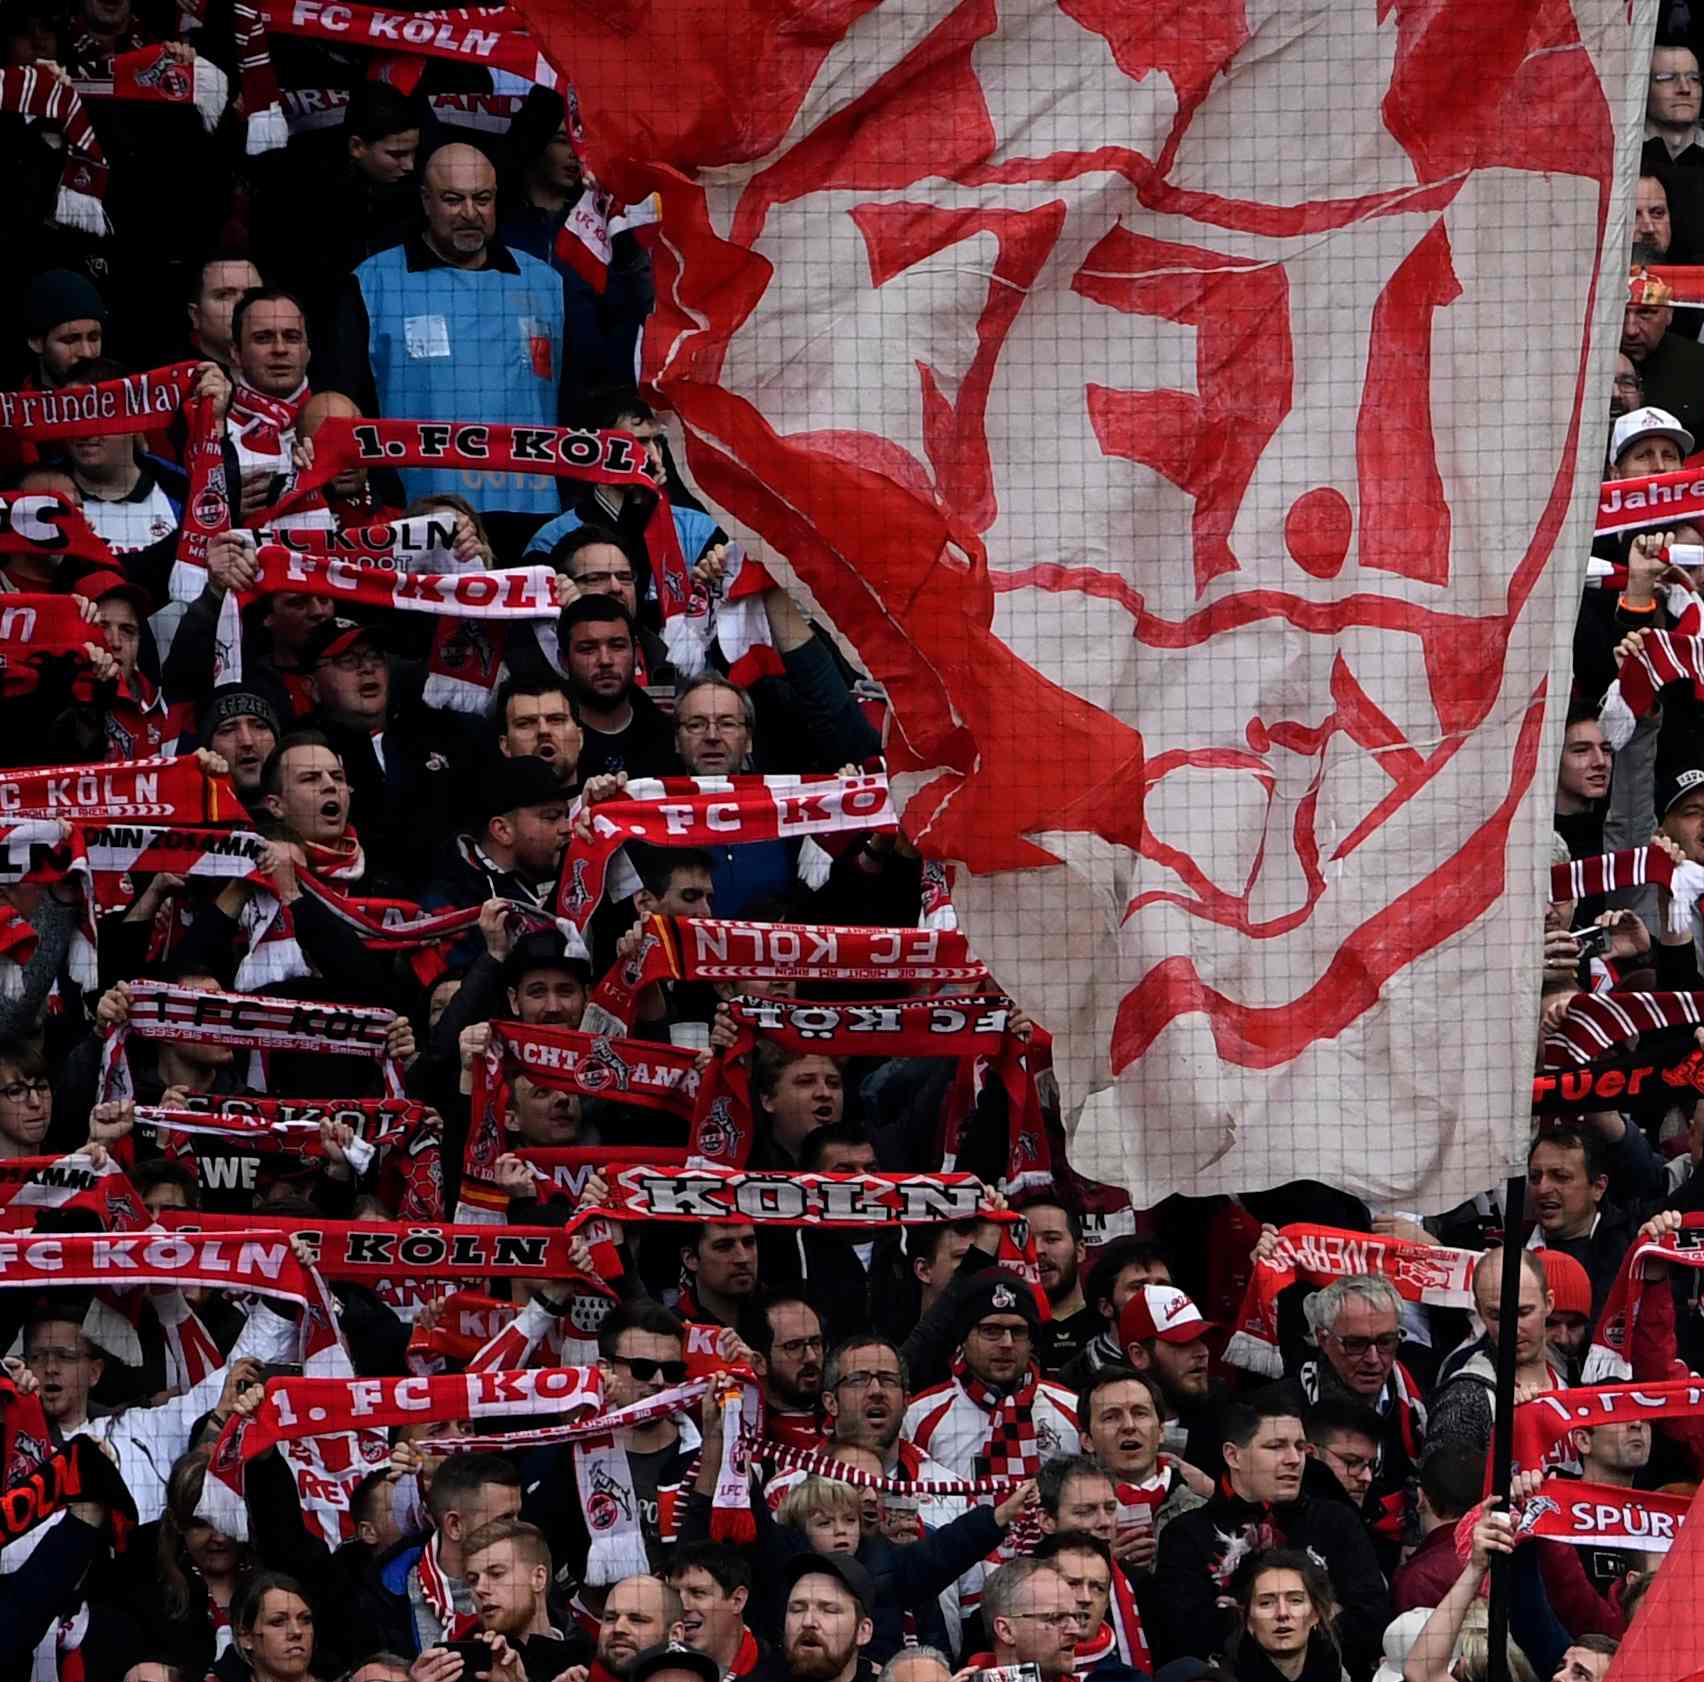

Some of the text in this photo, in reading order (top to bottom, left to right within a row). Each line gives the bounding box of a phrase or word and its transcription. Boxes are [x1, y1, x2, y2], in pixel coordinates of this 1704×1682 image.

[292, 1, 352, 32] FC
[354, 425, 486, 458] 1. FC
[50, 773, 158, 805] KÖLN
[668, 803, 743, 835] FC
[641, 1173, 985, 1219] KÖLN
[93, 1231, 289, 1278] KÖLN
[347, 1230, 550, 1268] KÖLN
[274, 1379, 432, 1426] 1. FC
